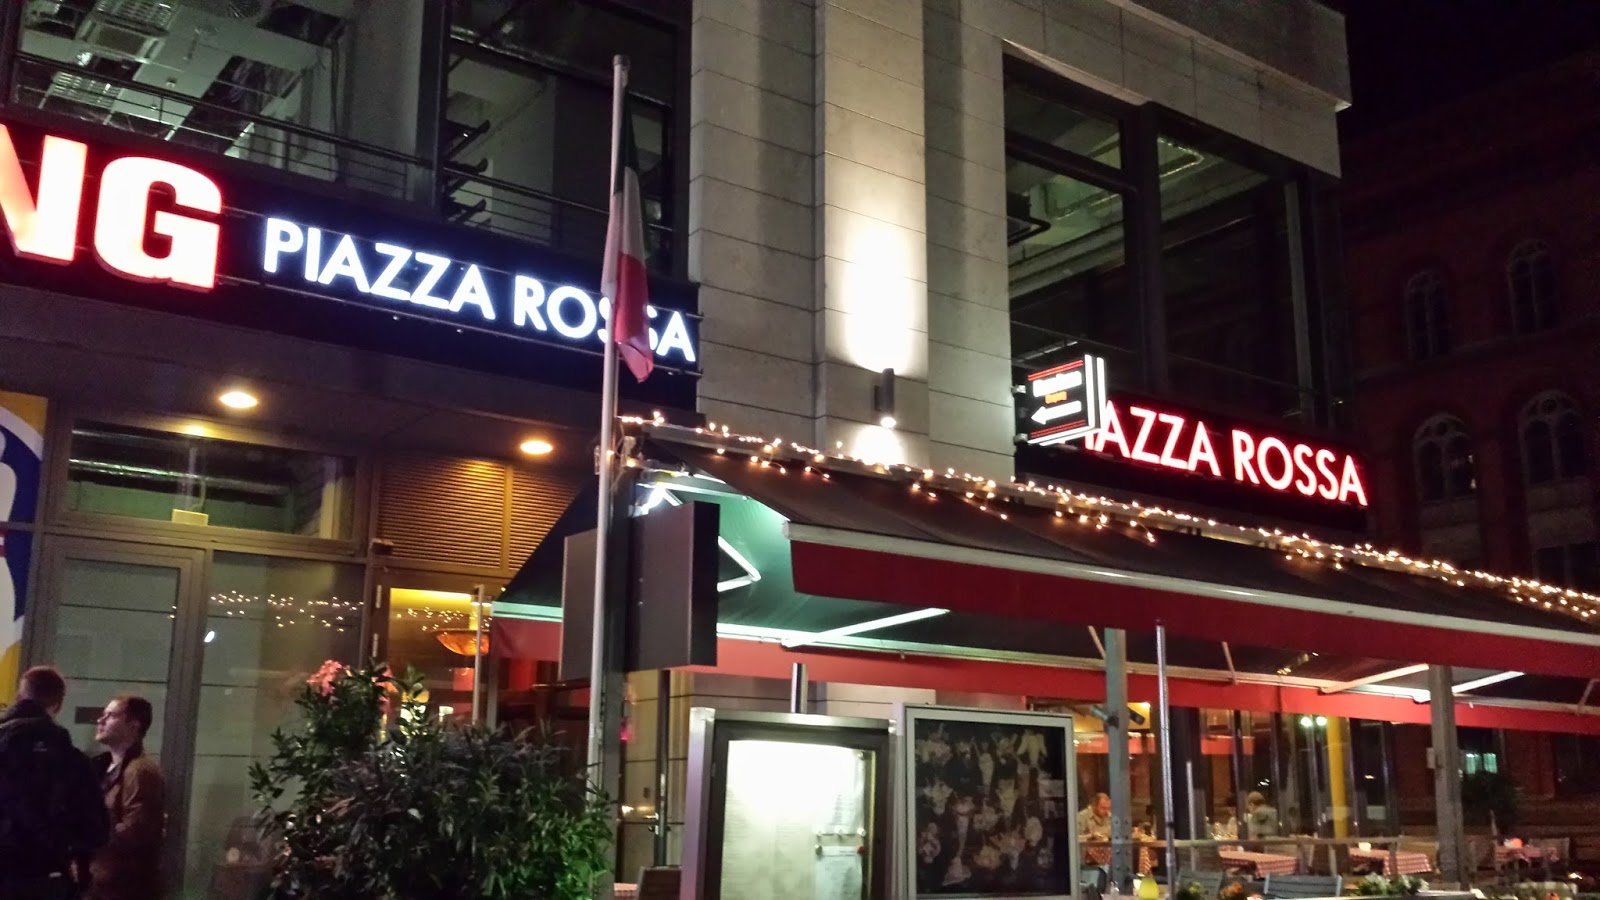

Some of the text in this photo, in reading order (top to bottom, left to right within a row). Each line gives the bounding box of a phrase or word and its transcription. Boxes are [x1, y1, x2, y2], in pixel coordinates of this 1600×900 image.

[264, 217, 496, 320] PIAZZA
[1060, 399, 1368, 506] AZZA ROSSA
